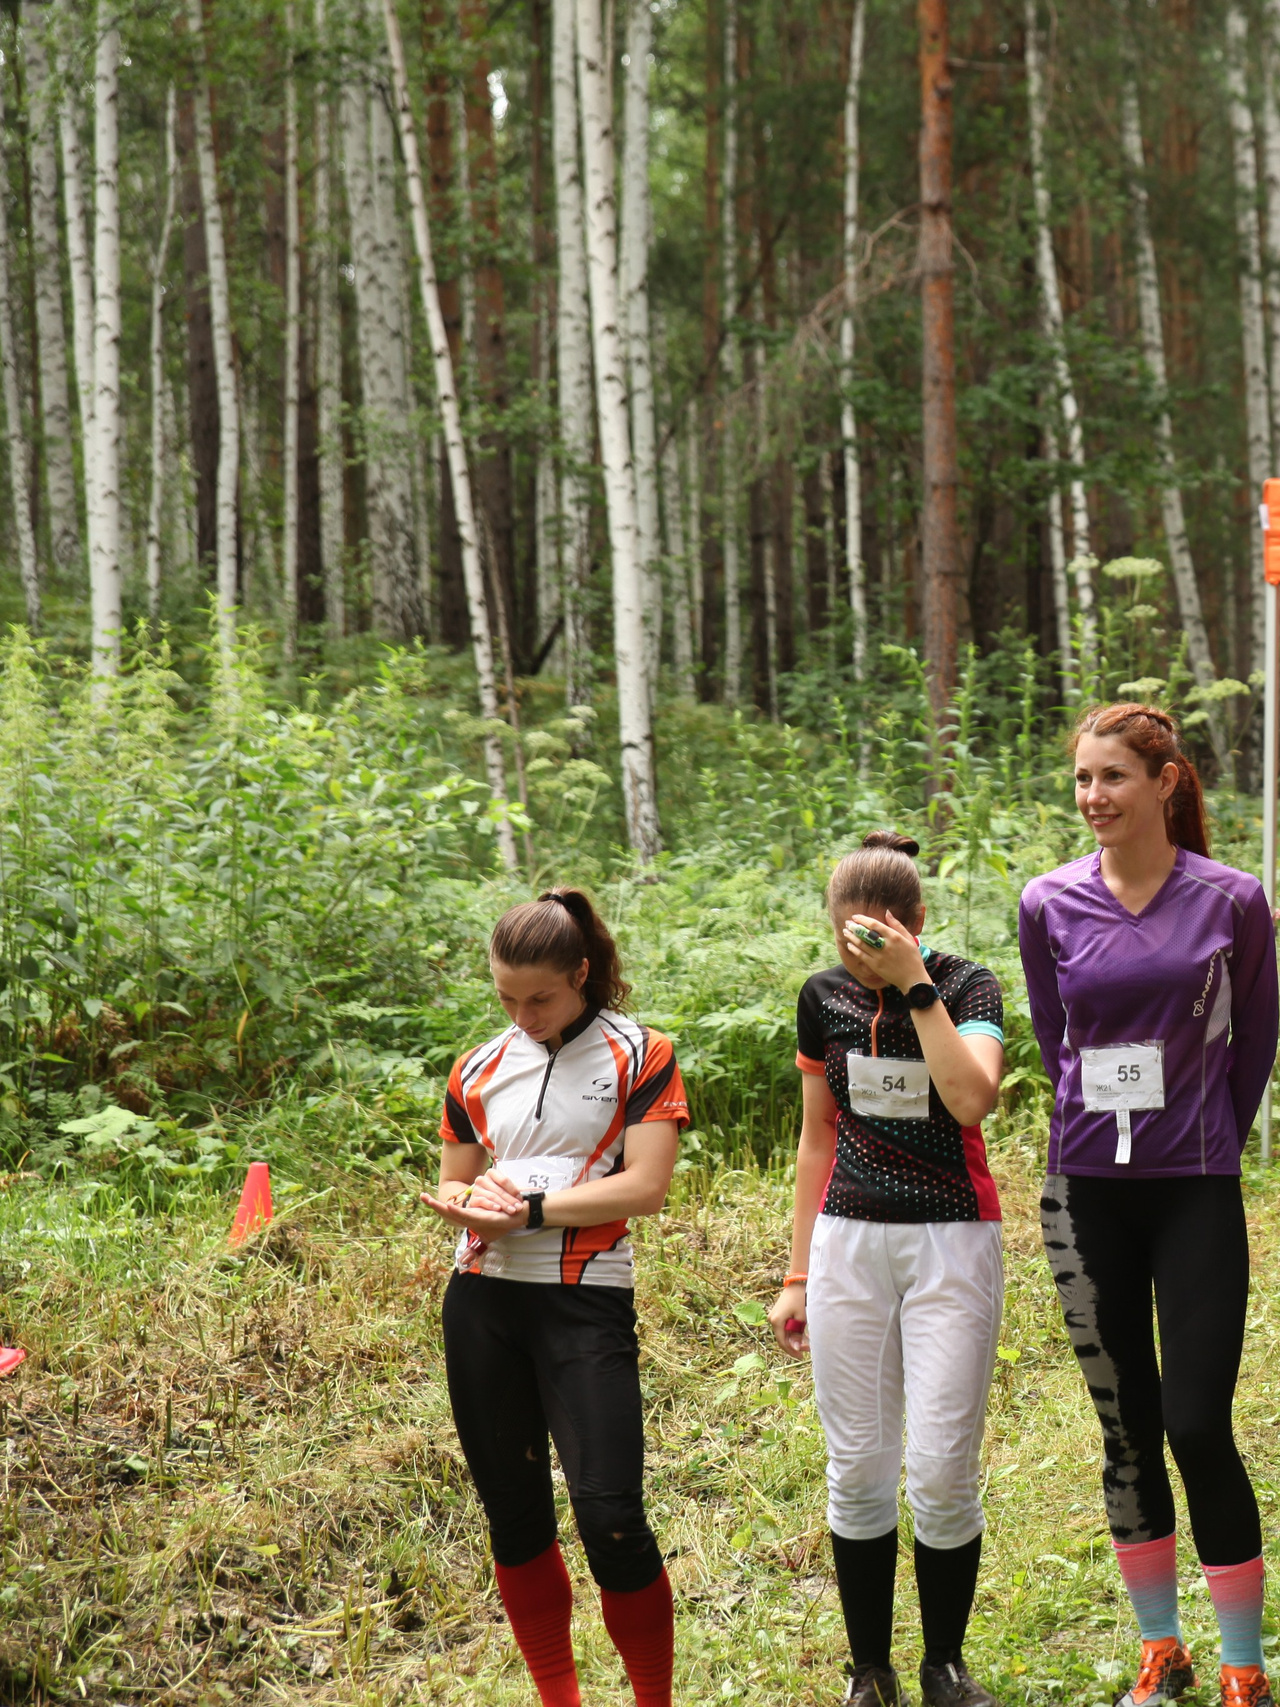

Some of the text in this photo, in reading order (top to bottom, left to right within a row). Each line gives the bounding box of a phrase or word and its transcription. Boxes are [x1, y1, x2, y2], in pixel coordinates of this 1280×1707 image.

[1117, 1064, 1141, 1083] 55
[882, 1075, 906, 1093] 54
[528, 1174, 550, 1190] 53
